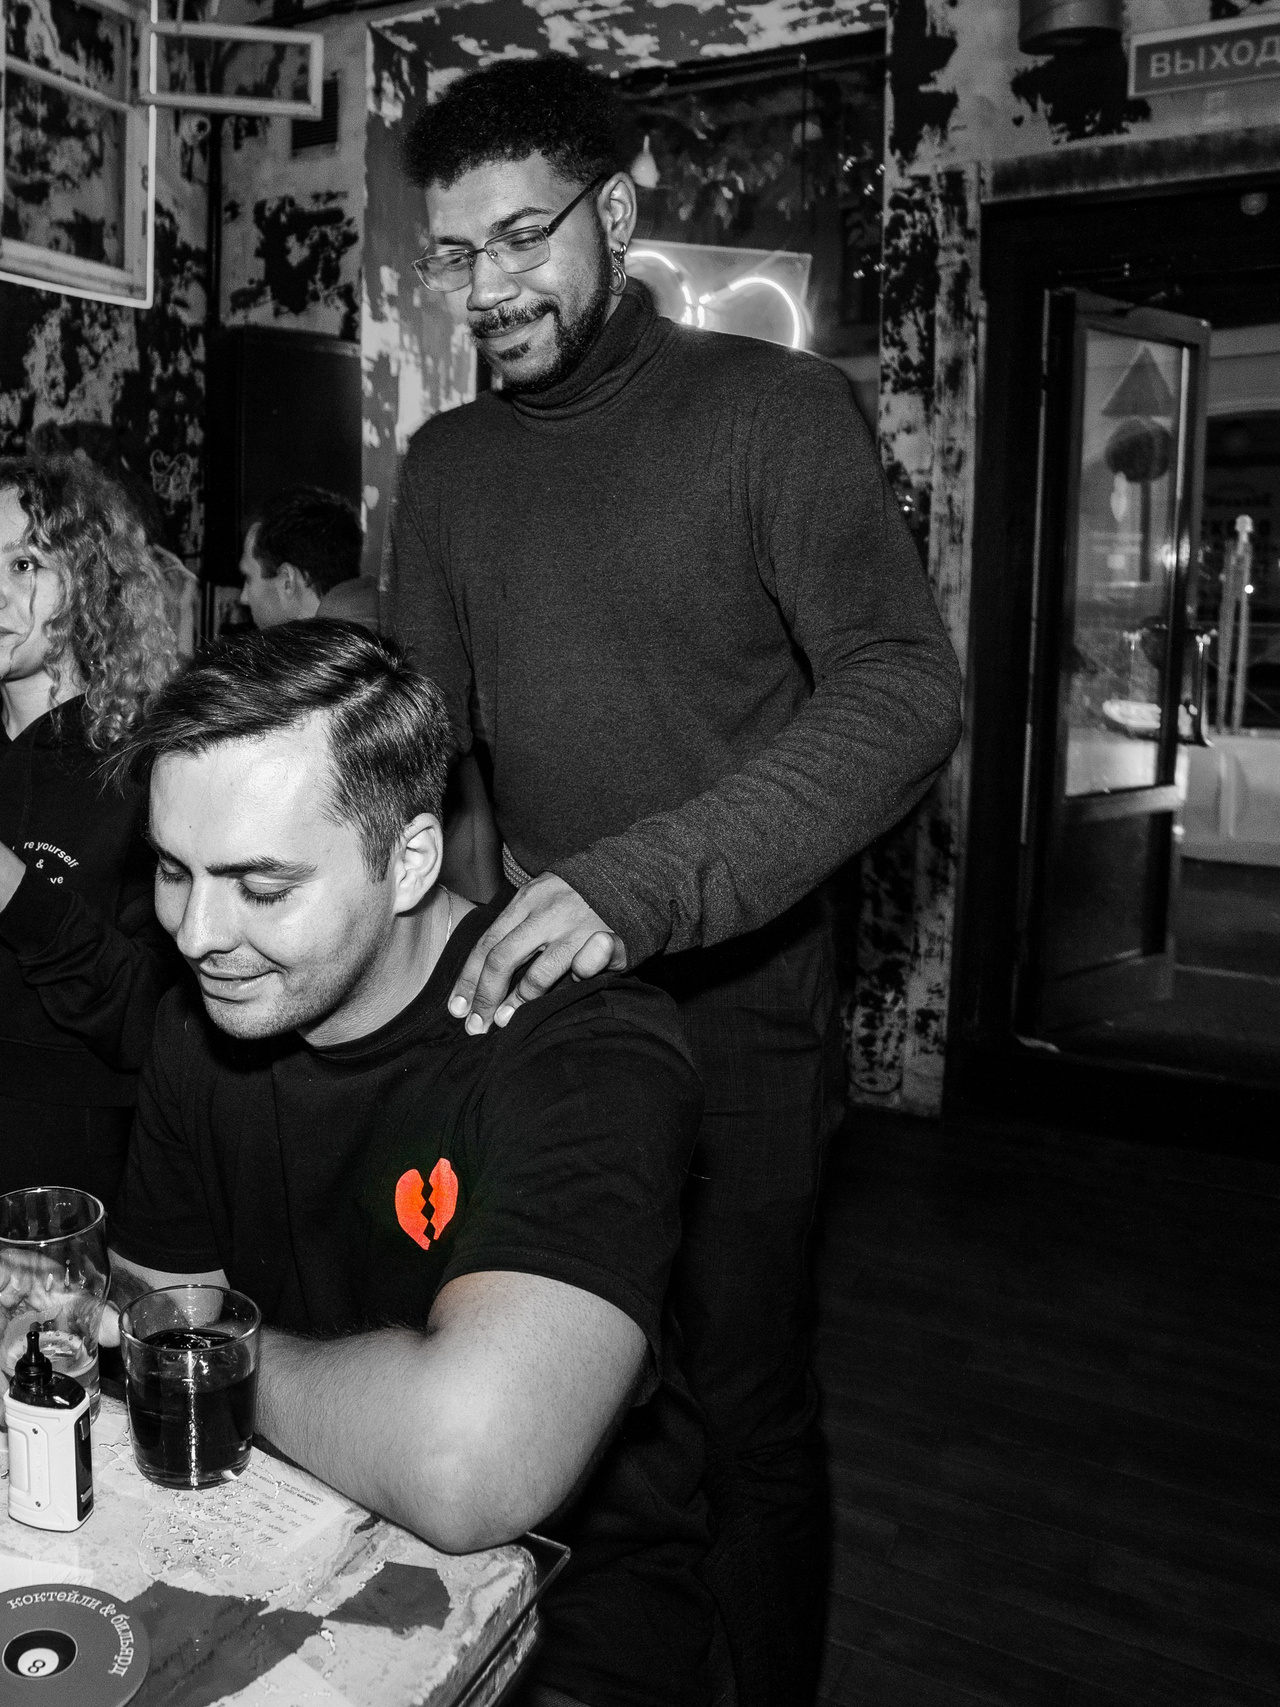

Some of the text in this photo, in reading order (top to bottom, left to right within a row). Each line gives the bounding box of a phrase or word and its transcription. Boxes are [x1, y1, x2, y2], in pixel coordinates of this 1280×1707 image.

[1150, 35, 1280, 78] ВЫХОД
[35, 841, 79, 869] yourself
[35, 858, 44, 869] &
[7, 1590, 102, 1610] коктейли
[99, 1603, 117, 1618] &
[108, 1614, 134, 1677] бильярд
[27, 1659, 46, 1674] 8
